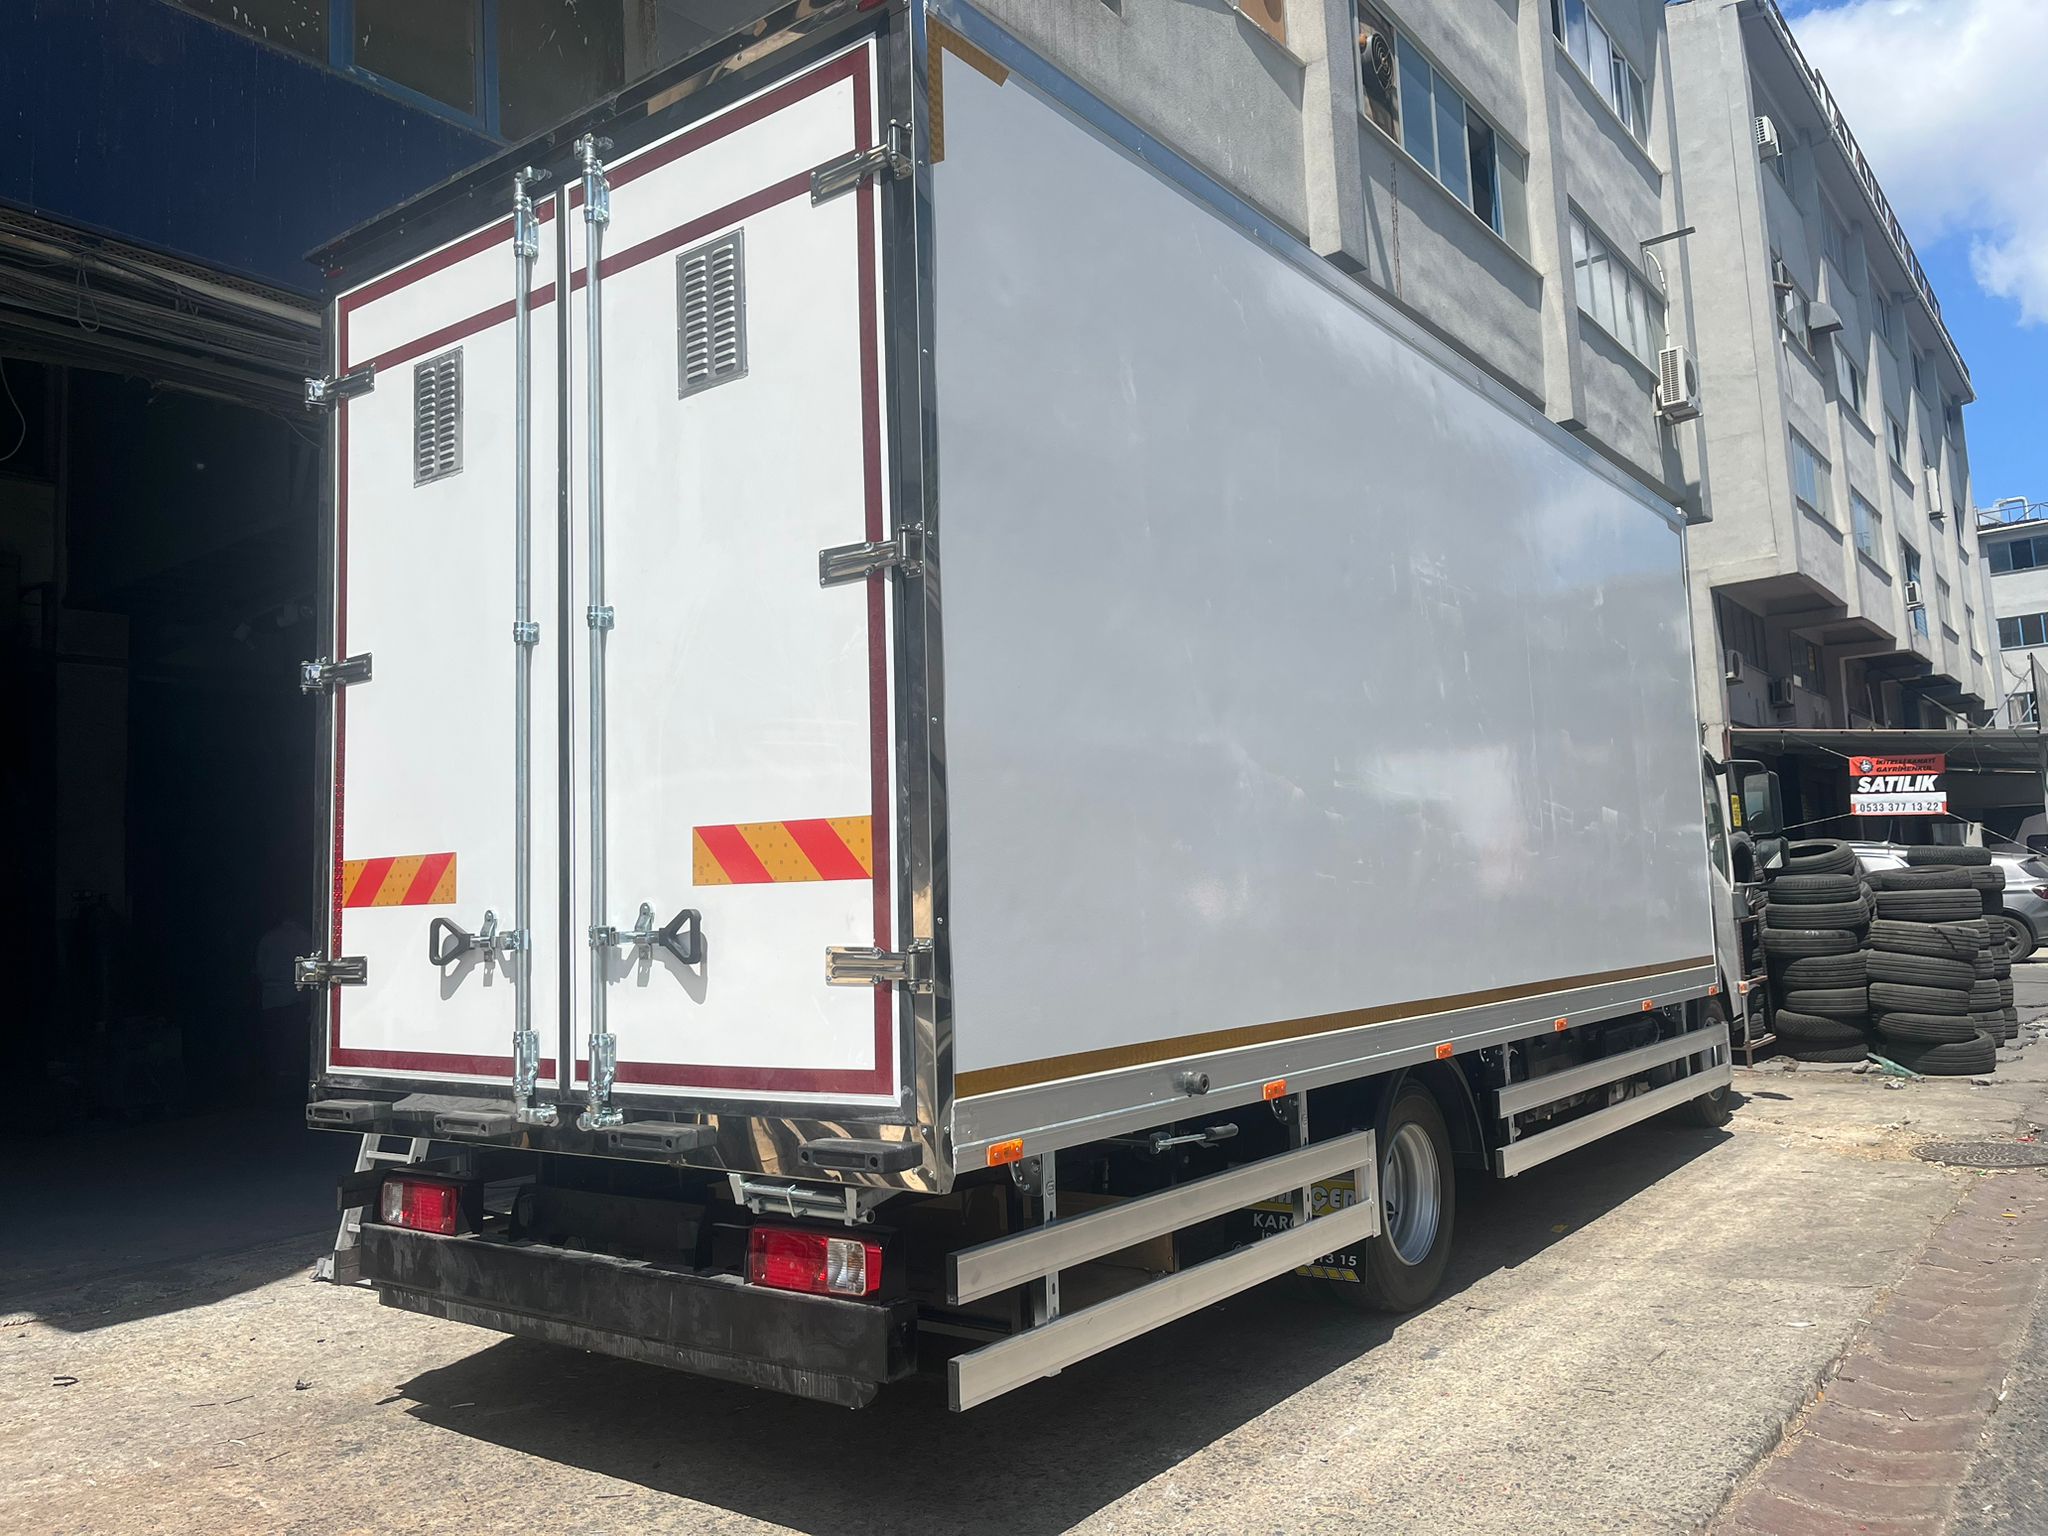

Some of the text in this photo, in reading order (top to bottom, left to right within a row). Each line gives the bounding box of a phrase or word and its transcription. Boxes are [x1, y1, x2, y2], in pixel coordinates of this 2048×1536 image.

[1857, 775, 1938, 793] SATILIK
[1859, 802, 1939, 812] 0533 377 13 22
[1340, 1254, 1357, 1266] 15
